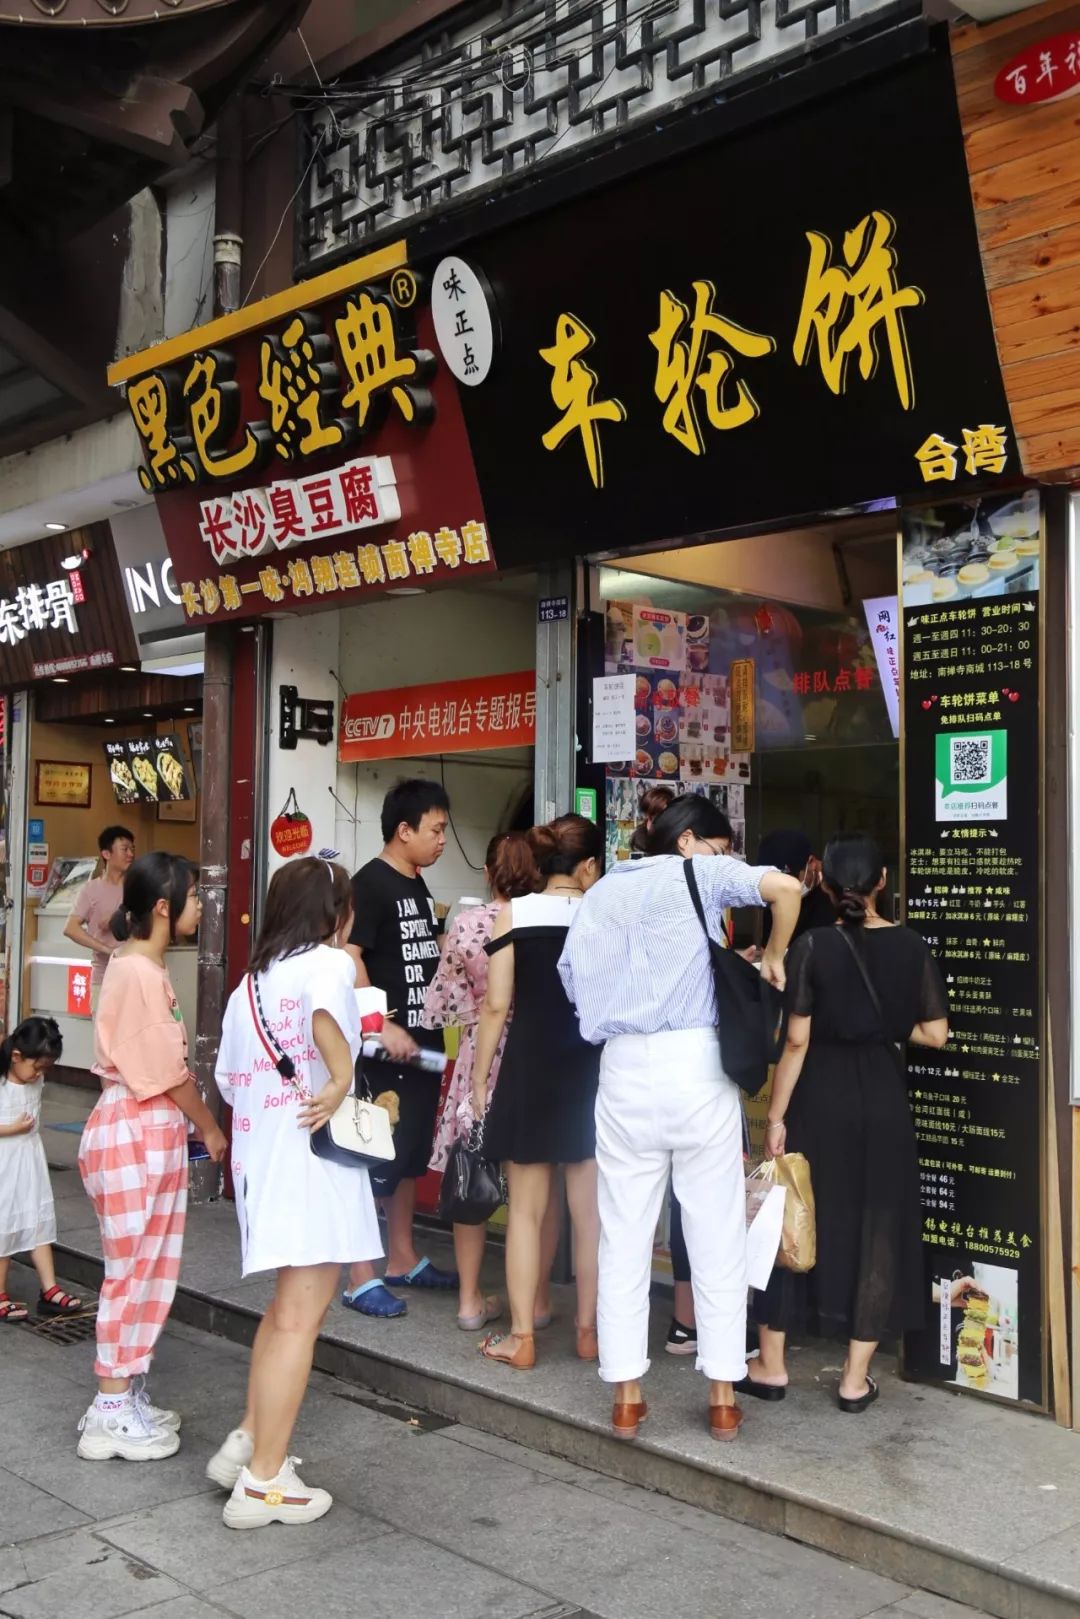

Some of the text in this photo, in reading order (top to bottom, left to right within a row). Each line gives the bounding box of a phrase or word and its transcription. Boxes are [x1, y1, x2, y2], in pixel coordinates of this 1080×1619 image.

[443, 268, 480, 375] 味正点
[539, 208, 926, 489] 车轮饼
[914, 423, 1008, 483] 台湾
[202, 463, 379, 559] 长沙臭豆腐
[921, 603, 1021, 624] 味正点车轮饼 营业时间
[940, 691, 1000, 708] 车轮饼菜单
[952, 829, 988, 838] 友情提示
[404, 964, 425, 984] OR
